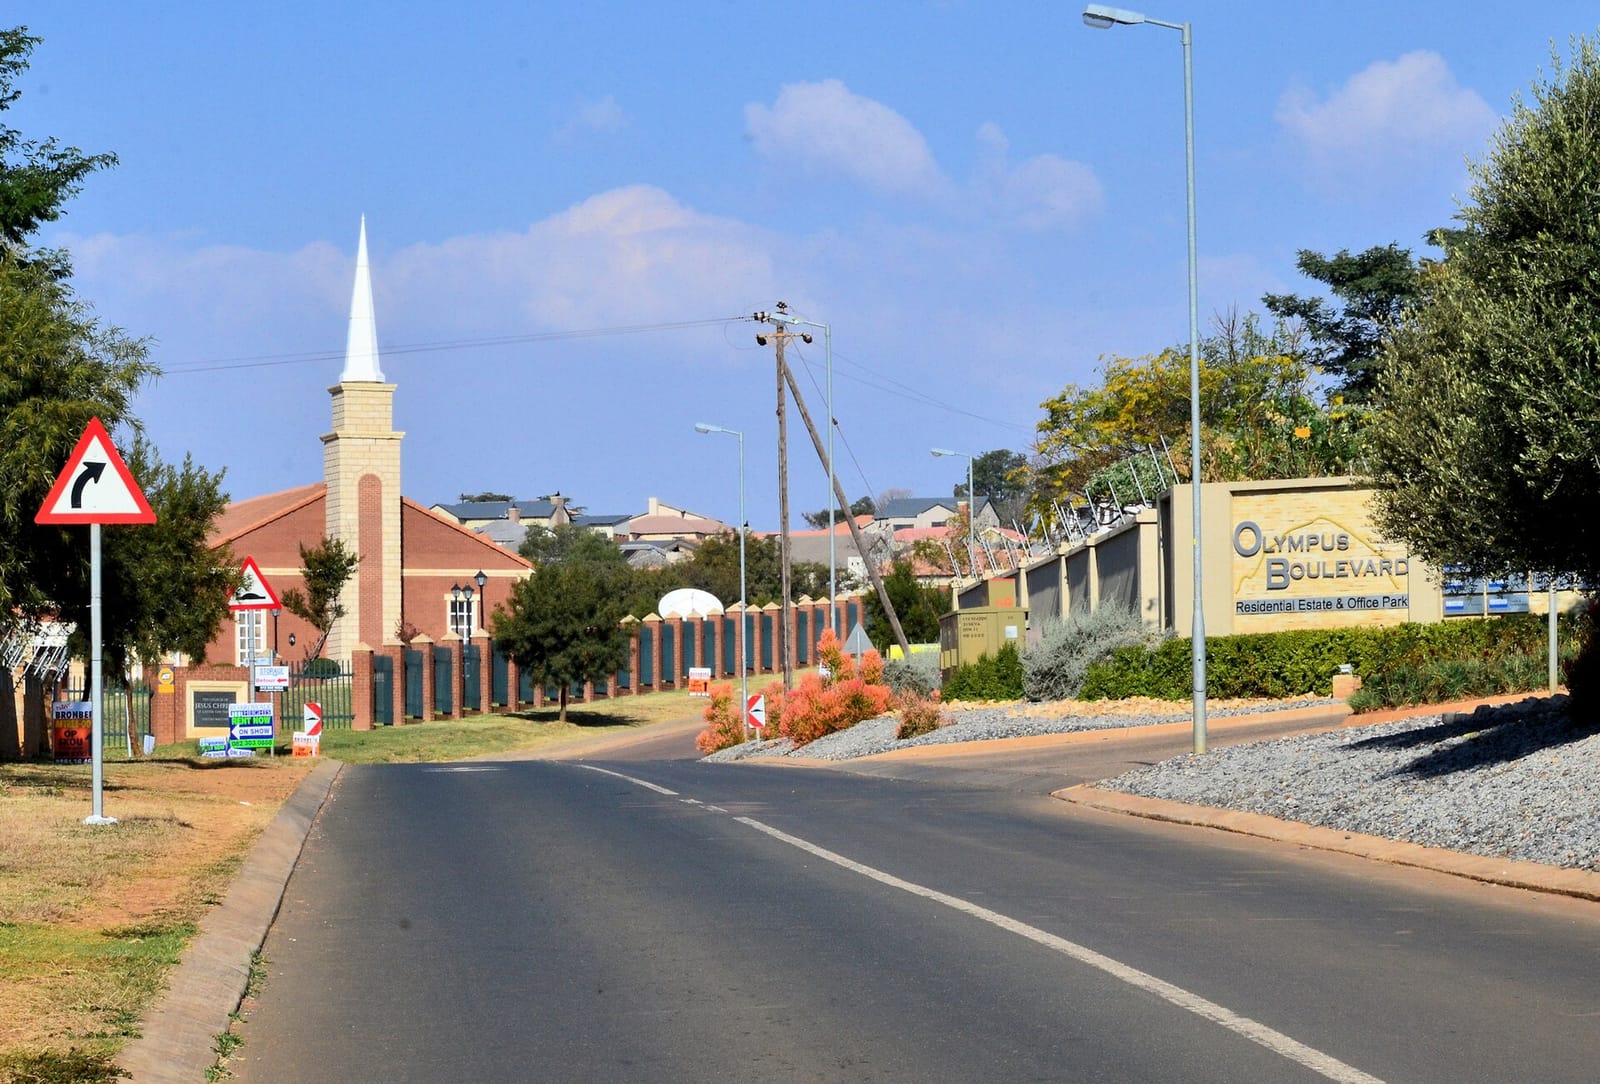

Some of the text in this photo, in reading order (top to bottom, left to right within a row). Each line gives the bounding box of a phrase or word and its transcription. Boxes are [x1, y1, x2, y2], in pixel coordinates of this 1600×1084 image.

[1233, 521, 1349, 557] OLYMPUS
[1266, 558, 1409, 590] BOULEVARD
[1236, 596, 1408, 613] Residential Estate & Office Park
[252, 716, 271, 724] NOW
[64, 730, 77, 738] OP
